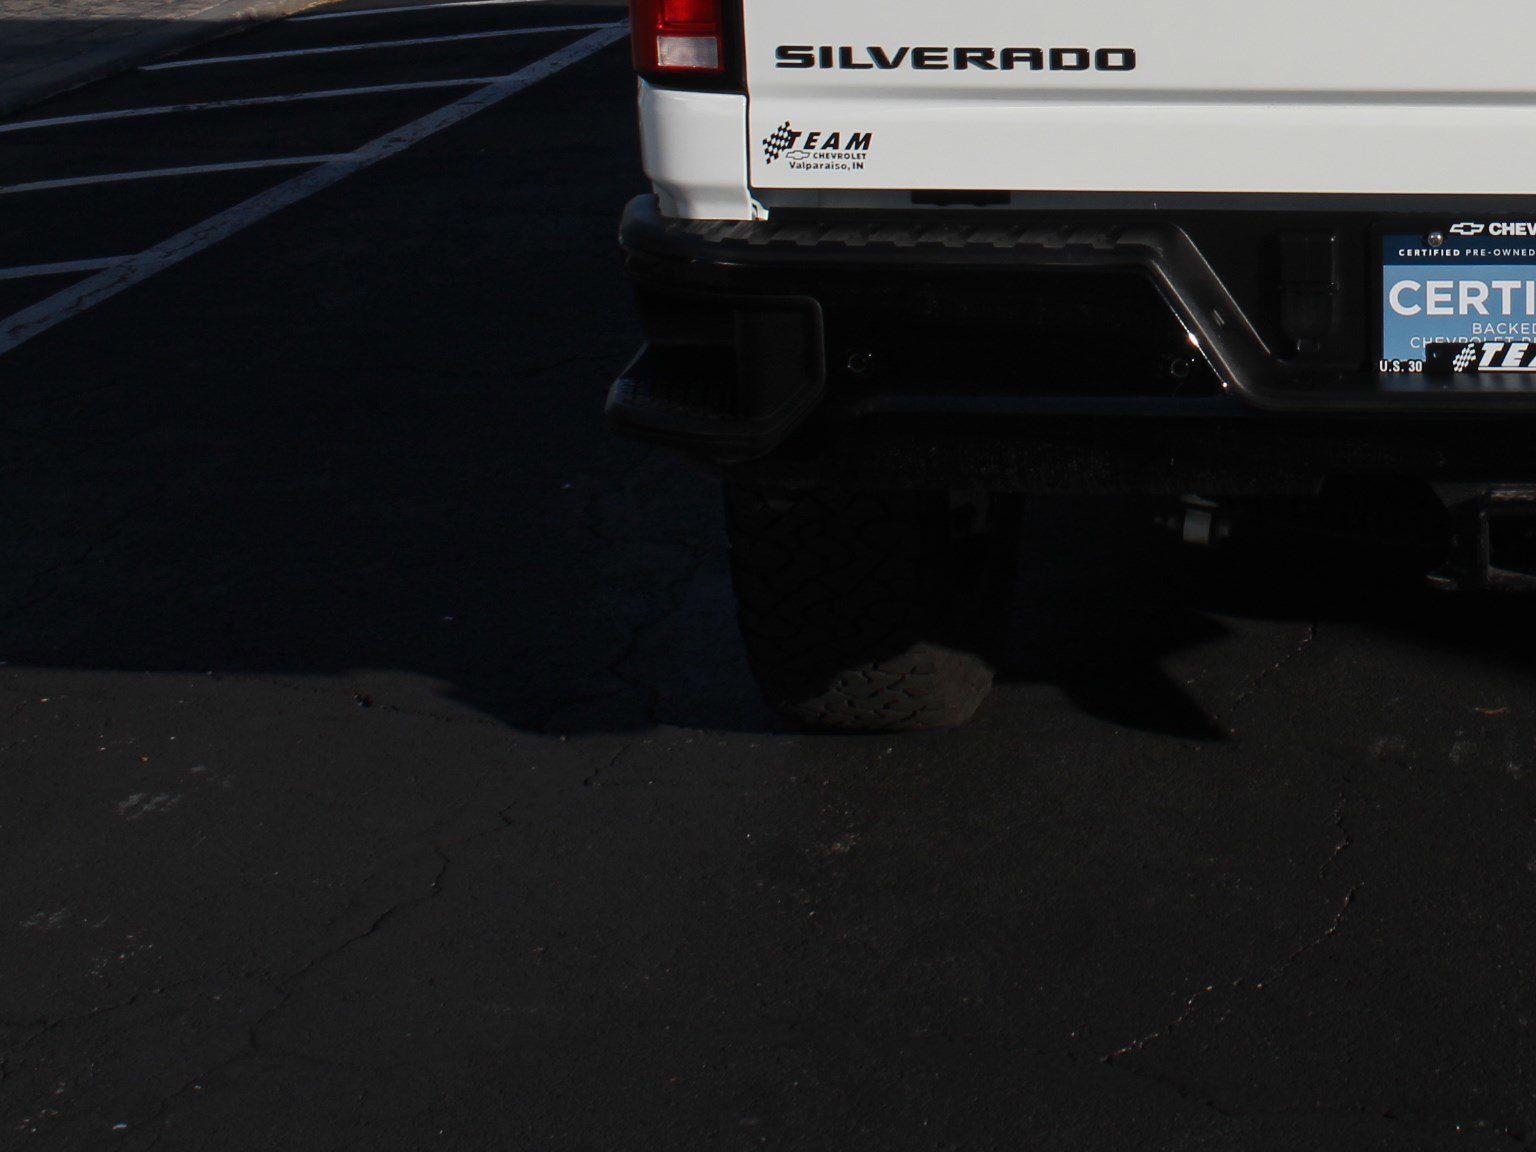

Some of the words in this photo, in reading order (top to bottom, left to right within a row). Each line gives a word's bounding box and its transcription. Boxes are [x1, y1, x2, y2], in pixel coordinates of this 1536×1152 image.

[775, 45, 1136, 71] SILVERADO
[786, 131, 872, 150] TEAM
[813, 152, 866, 160] CHEVROLET
[789, 161, 850, 171] Valparaiso,
[1398, 248, 1461, 257] CERTIFIED
[1465, 248, 1536, 257] PRE-OWNED
[1379, 360, 1404, 372] U.S.
[1408, 360, 1422, 372] 30
